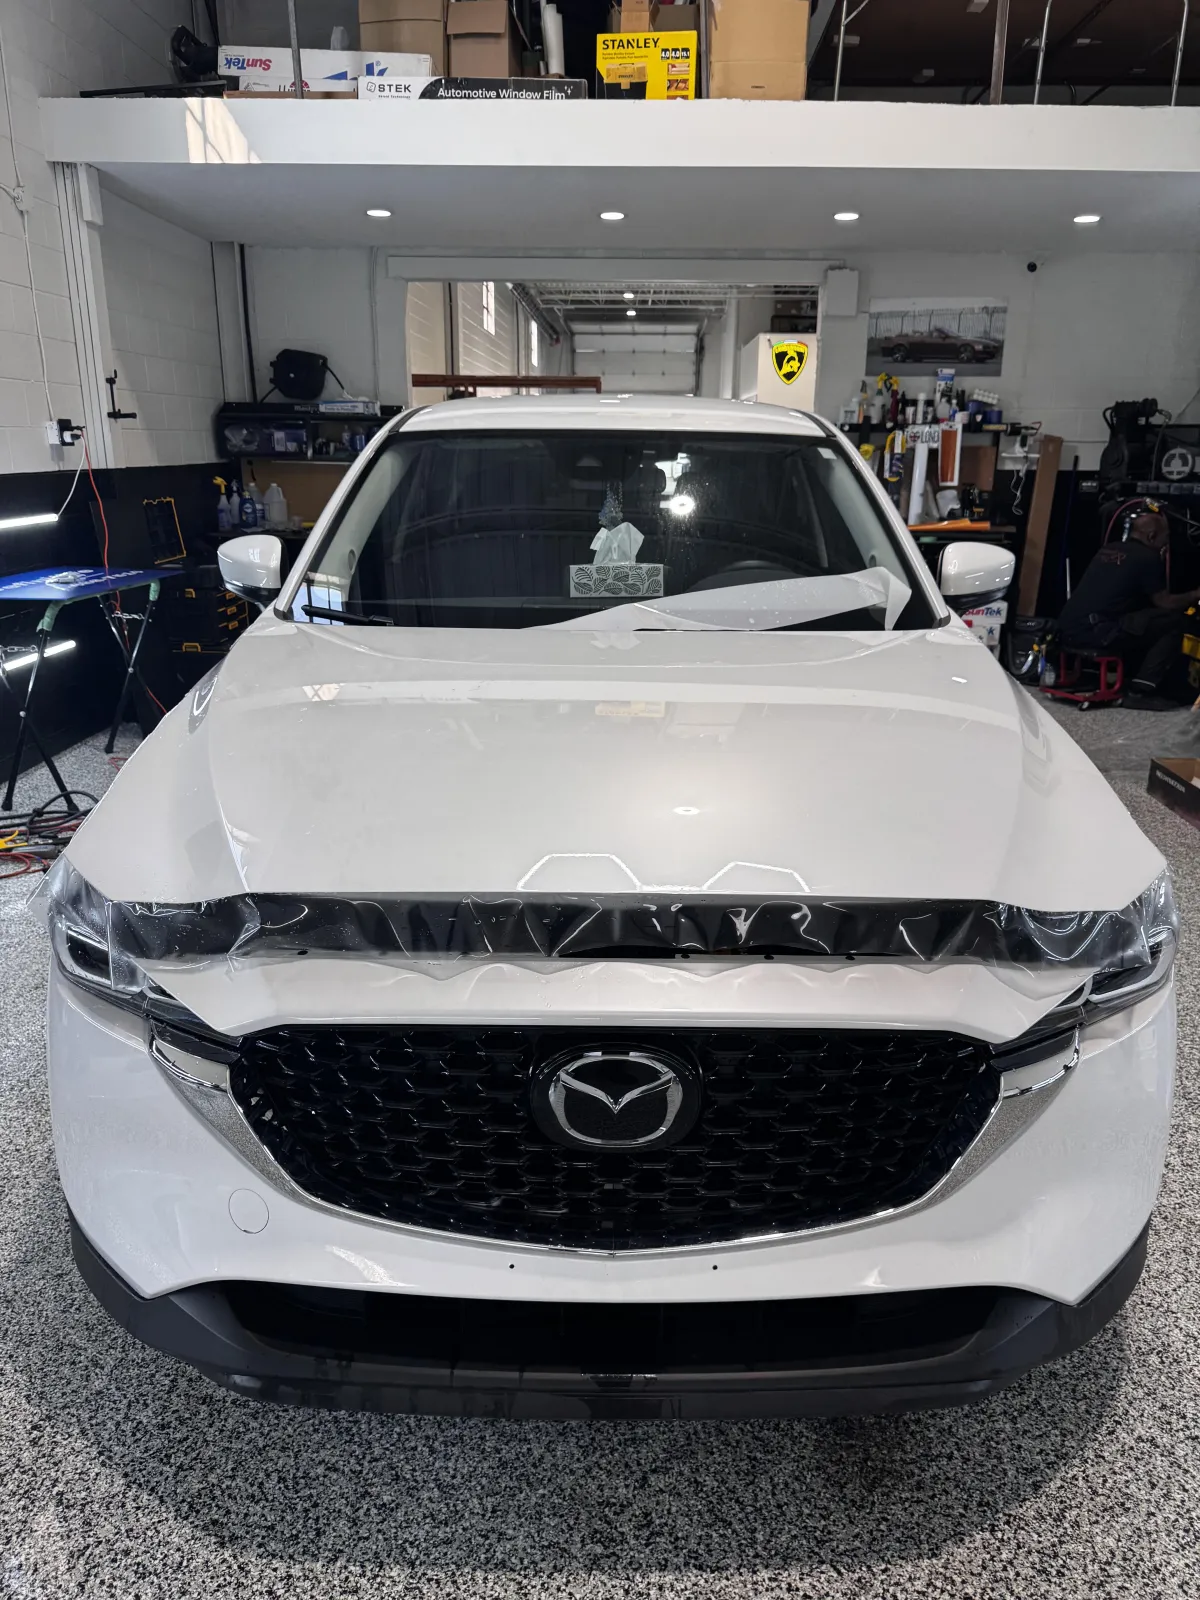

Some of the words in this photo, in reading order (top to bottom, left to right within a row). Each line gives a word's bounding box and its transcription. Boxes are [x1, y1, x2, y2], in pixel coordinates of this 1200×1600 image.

[602, 37, 660, 50] STANLEY
[224, 57, 272, 71] SunTek
[378, 84, 412, 93] STEK
[437, 87, 497, 98] Automotive
[499, 88, 541, 99] Window
[543, 89, 566, 100] Film
[920, 431, 940, 443] LOND
